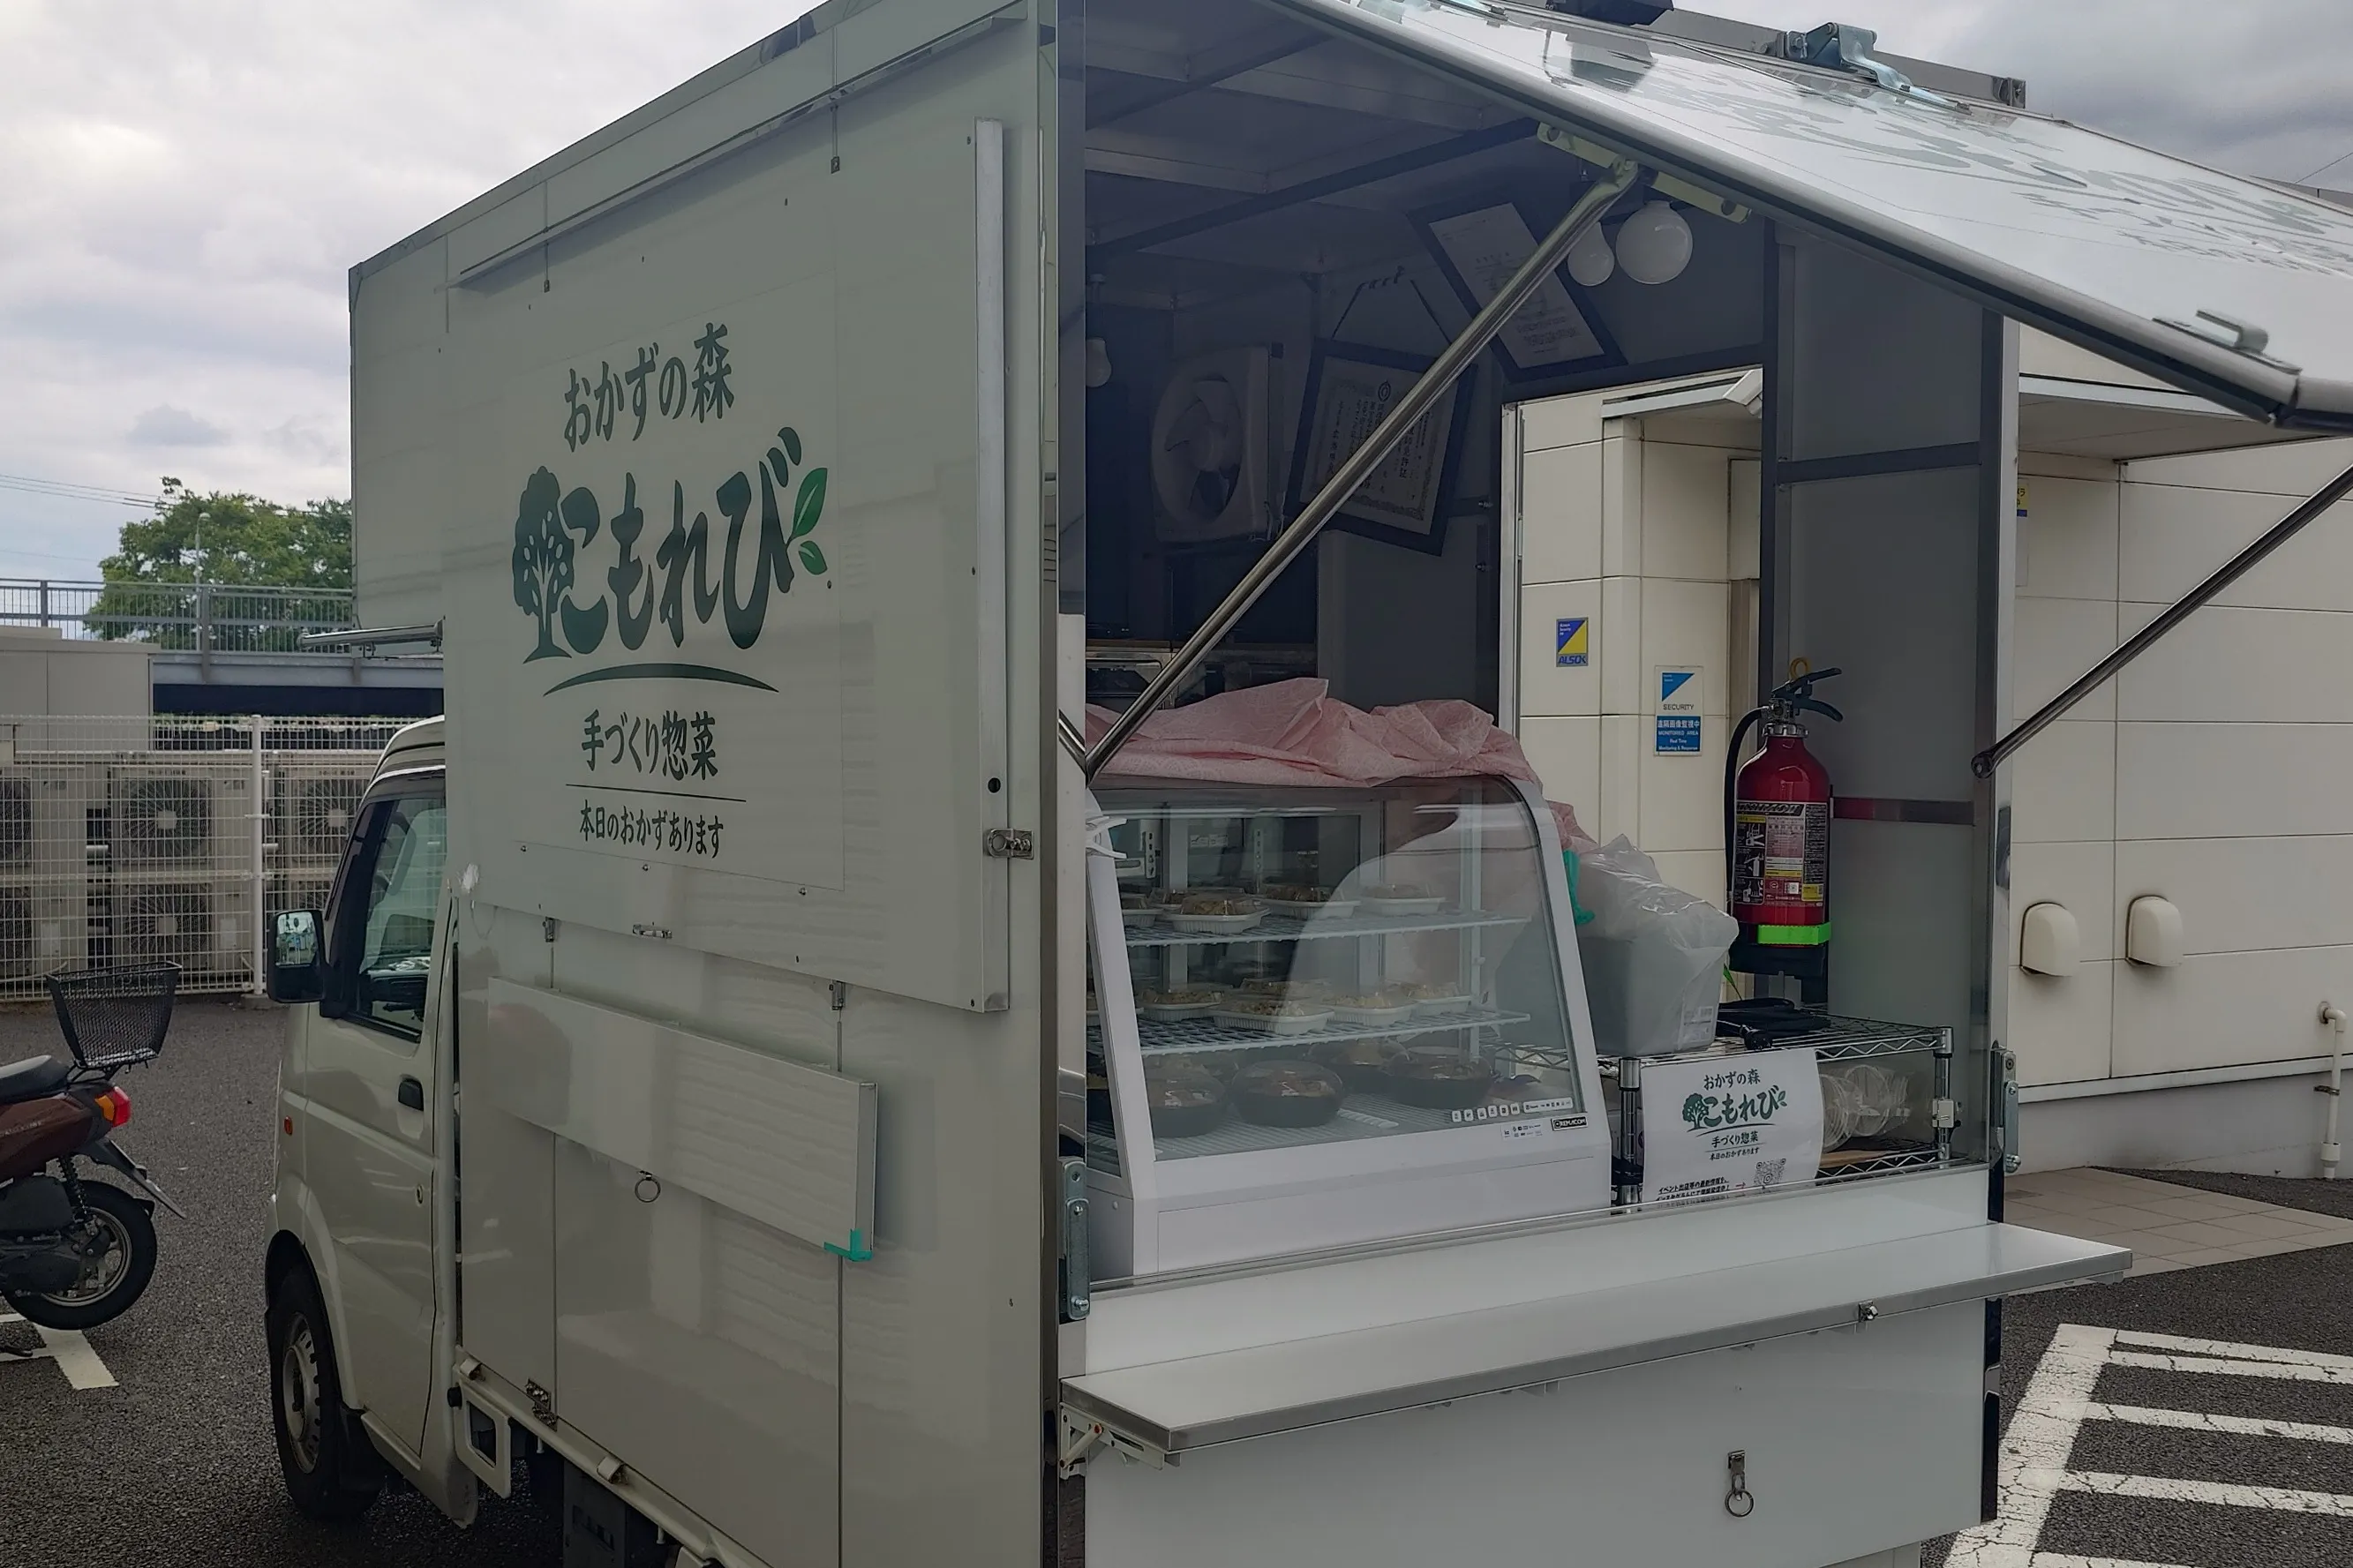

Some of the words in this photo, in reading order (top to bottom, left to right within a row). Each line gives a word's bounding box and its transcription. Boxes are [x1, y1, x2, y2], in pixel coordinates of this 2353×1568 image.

[564, 323, 734, 453] おかずの森
[559, 426, 802, 655] こもれび
[1559, 655, 1587, 664] ALSOK
[581, 709, 719, 782] 手づくり惣菜
[579, 799, 724, 859] 本日のおかずあります
[1703, 1069, 1761, 1091] おかずの森
[1703, 1084, 1780, 1128] こもれび
[1711, 1131, 1759, 1148] 手づくり惣菜
